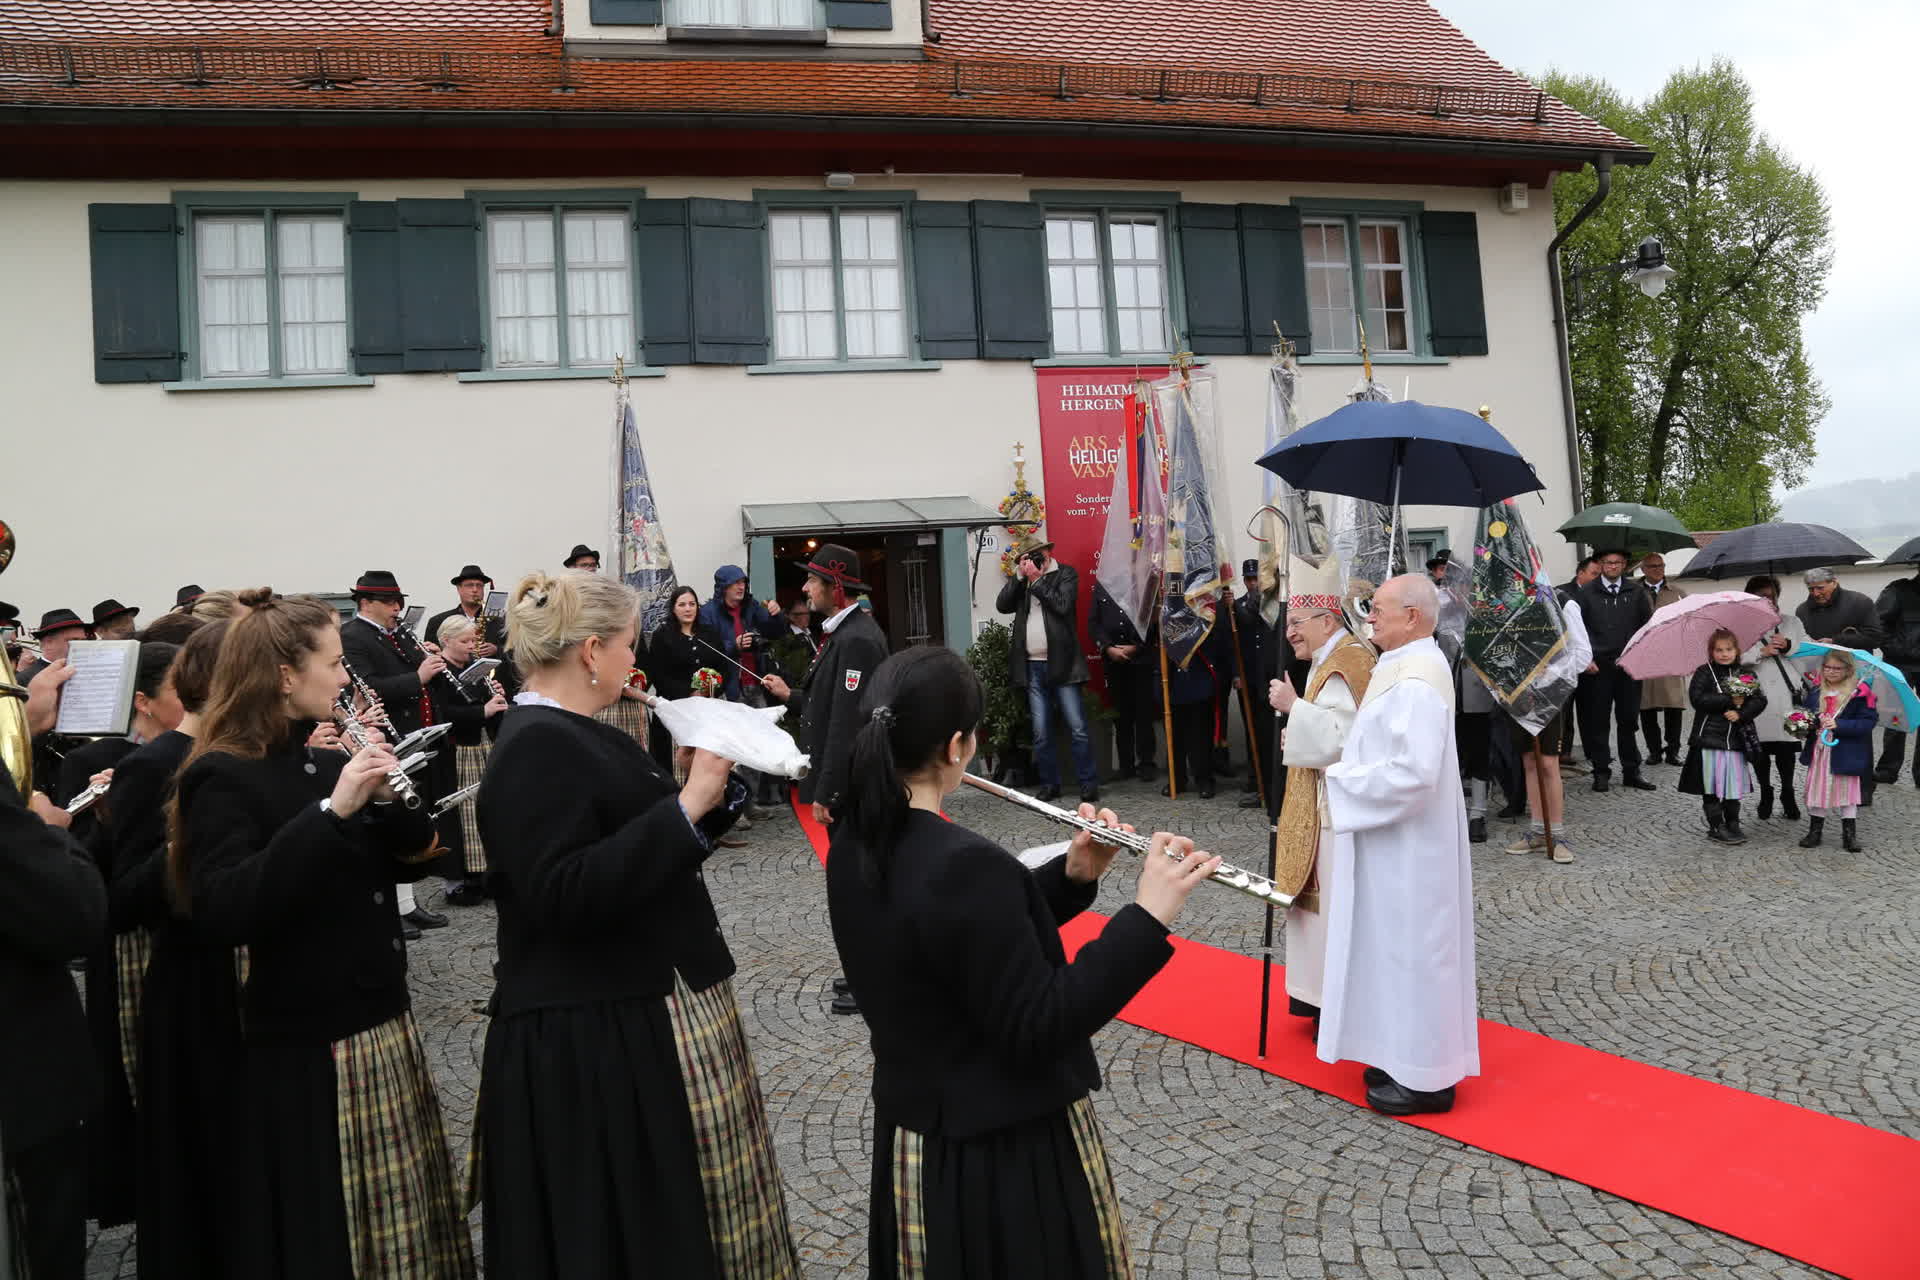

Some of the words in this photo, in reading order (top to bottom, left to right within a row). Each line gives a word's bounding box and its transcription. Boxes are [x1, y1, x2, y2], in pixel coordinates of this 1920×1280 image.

[1062, 384, 1135, 396] HEIMATM
[1061, 399, 1124, 411] HERGEN
[1069, 435, 1108, 450] ARS
[1071, 463, 1116, 478] VASA
[1075, 493, 1111, 504] Sonder
[1066, 508, 1087, 516] vom
[981, 536, 993, 547] 20
